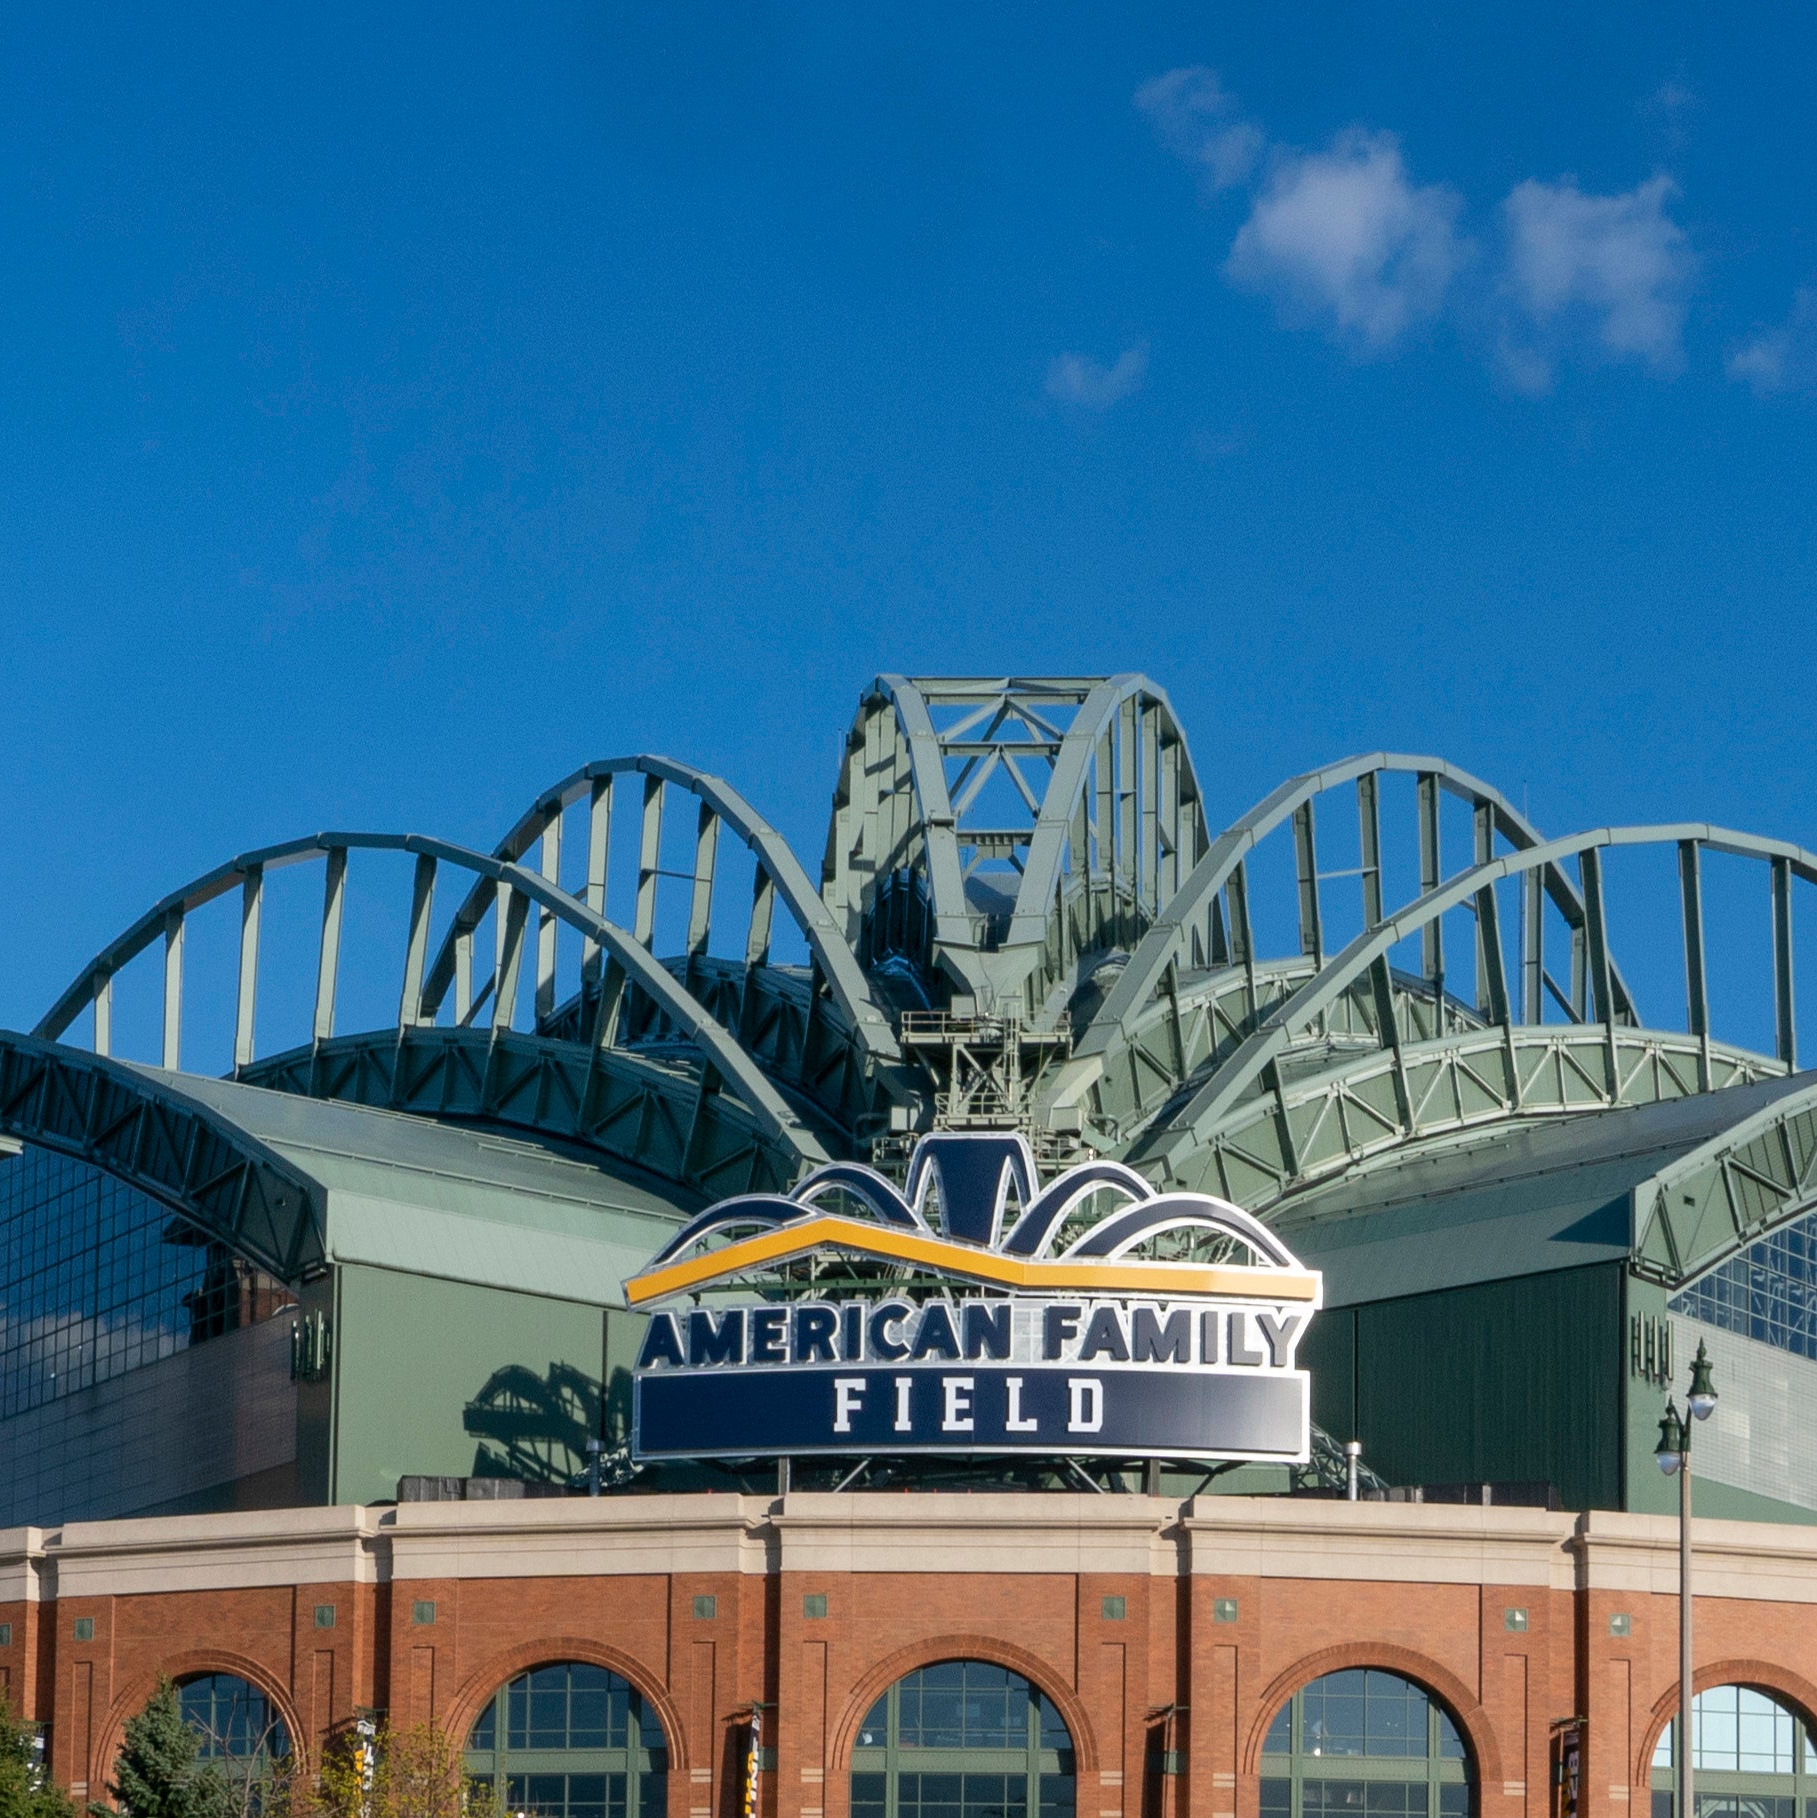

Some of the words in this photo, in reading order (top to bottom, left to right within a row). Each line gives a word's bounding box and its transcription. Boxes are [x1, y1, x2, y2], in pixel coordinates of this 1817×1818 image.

[638, 1304, 1013, 1367] AMERICAN
[1043, 1305, 1302, 1367] FAMILY
[833, 1377, 1106, 1434] FIELD
